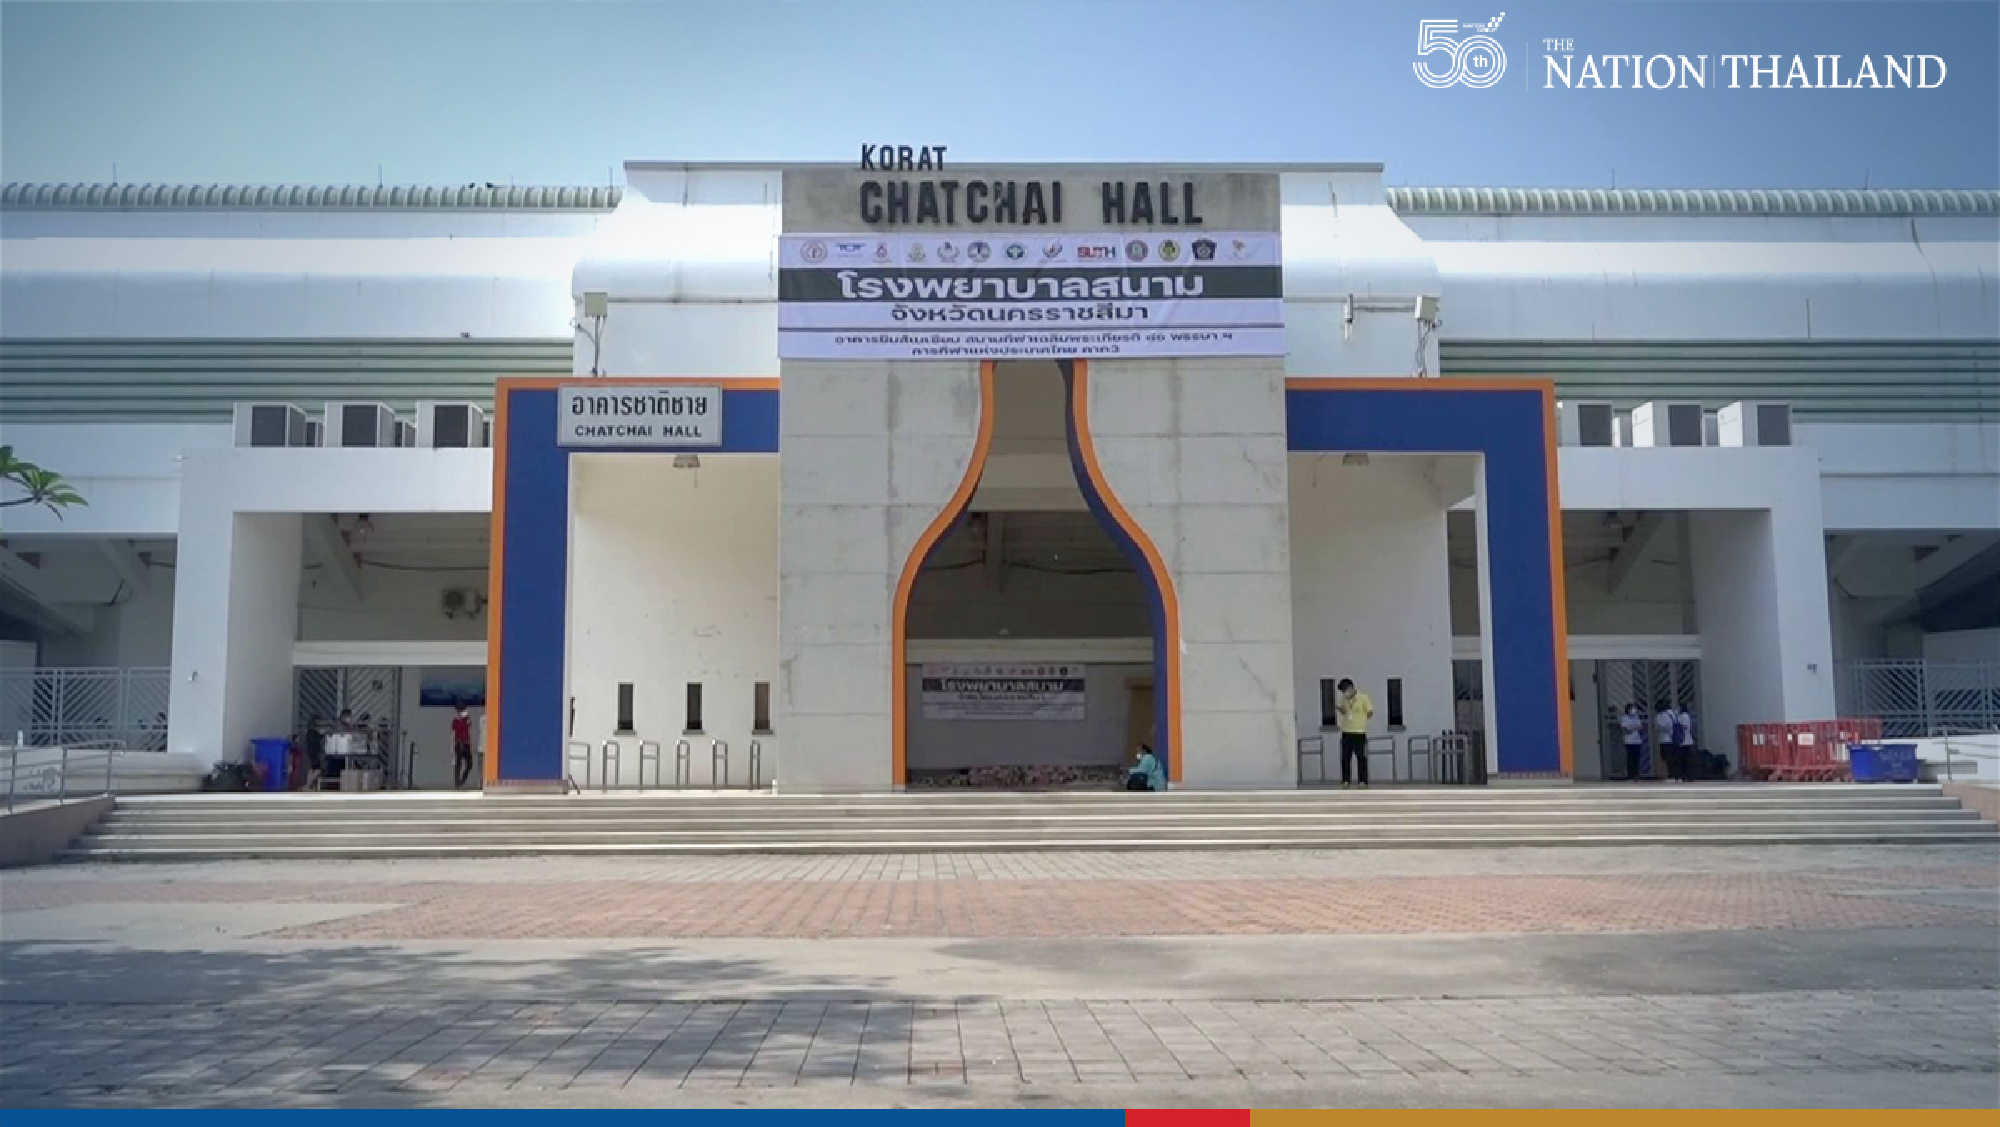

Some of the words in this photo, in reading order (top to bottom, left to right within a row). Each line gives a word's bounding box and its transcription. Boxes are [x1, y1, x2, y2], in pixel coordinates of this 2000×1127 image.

[861, 143, 948, 171] KORAT
[860, 181, 1062, 224] CHATCHAI
[1102, 181, 1204, 224] HALL
[837, 270, 1204, 299] โรงพยาบาลสนาม
[891, 303, 1150, 322] จังหวัดนครราชสีมา
[572, 390, 708, 416] อาคารชาติชาย
[574, 424, 653, 438] CHATCHAI
[662, 424, 703, 438] HALL
